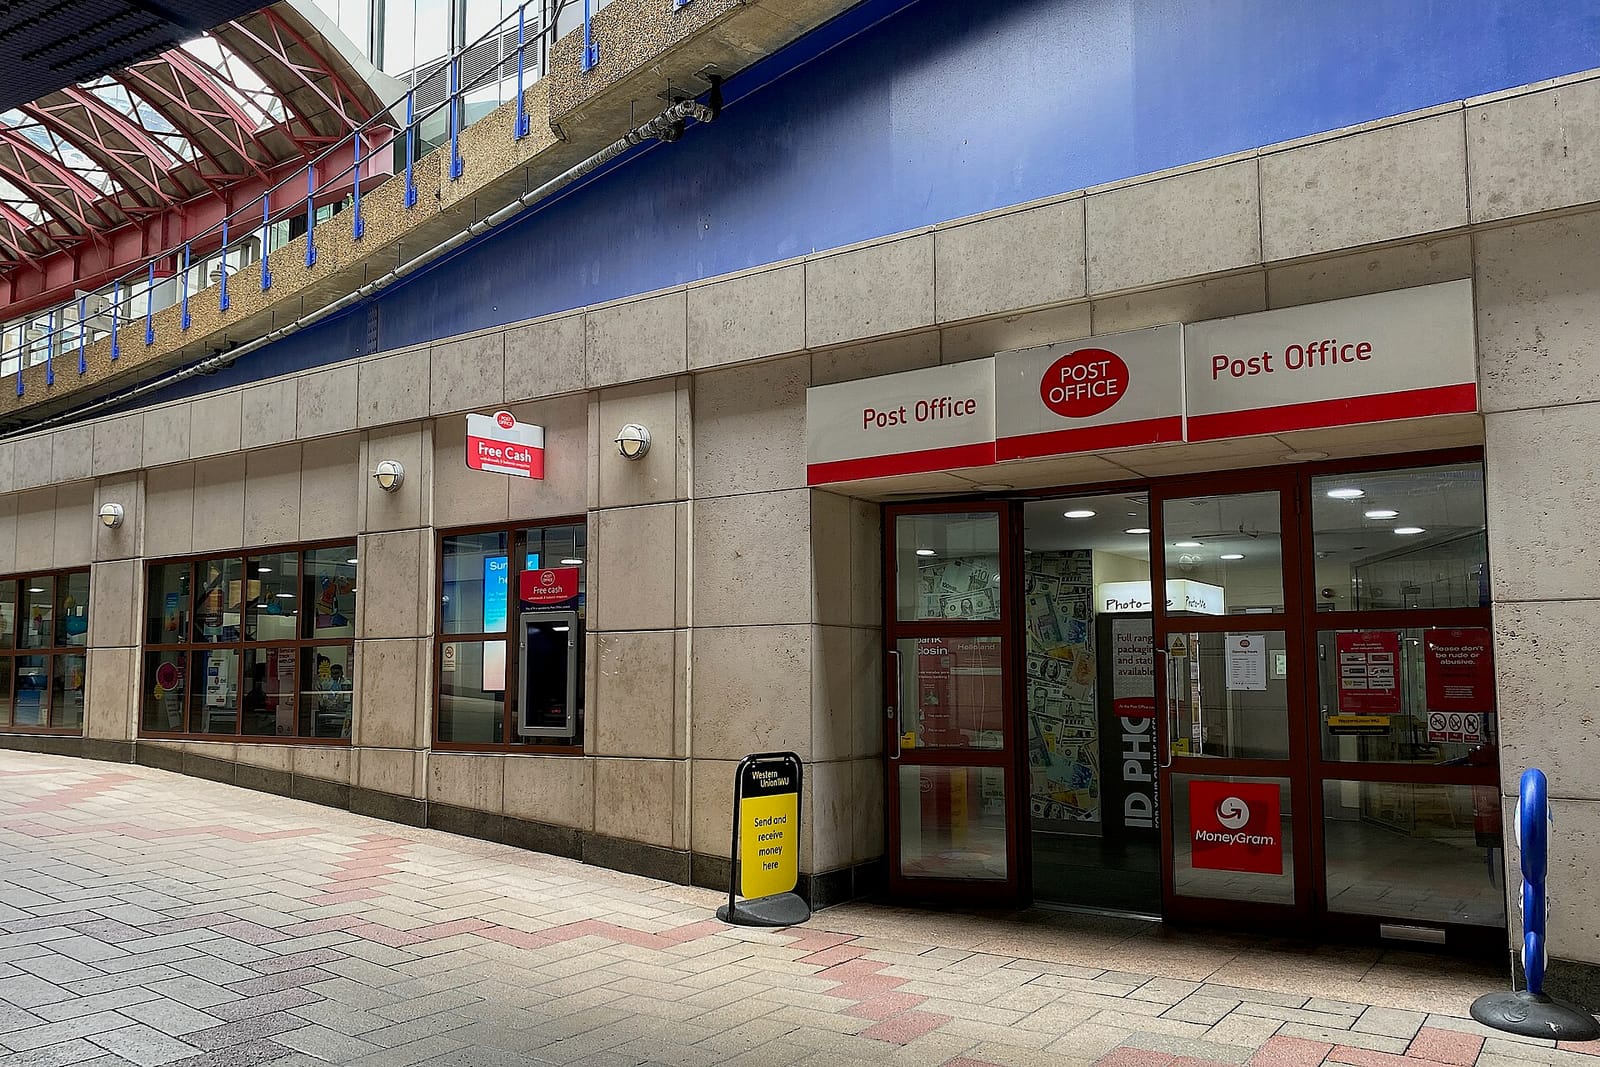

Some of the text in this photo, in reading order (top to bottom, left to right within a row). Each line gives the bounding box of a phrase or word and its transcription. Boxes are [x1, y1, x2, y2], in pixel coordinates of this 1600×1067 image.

[1211, 339, 1373, 380] Post Office
[1060, 360, 1111, 383] POST
[1049, 378, 1119, 404] OFFICE
[863, 396, 977, 430] Post Office
[478, 441, 502, 457] Free
[505, 447, 531, 463] Cash
[533, 585, 563, 595] Free cash
[1117, 633, 1132, 642] Full
[1117, 656, 1134, 664] and
[751, 770, 778, 780] Western
[1124, 792, 1153, 828] ID
[754, 814, 787, 828] Send and
[758, 830, 784, 842] receive
[1195, 829, 1274, 846] MoneyGram
[758, 846, 783, 857] money
[762, 861, 779, 871] here
